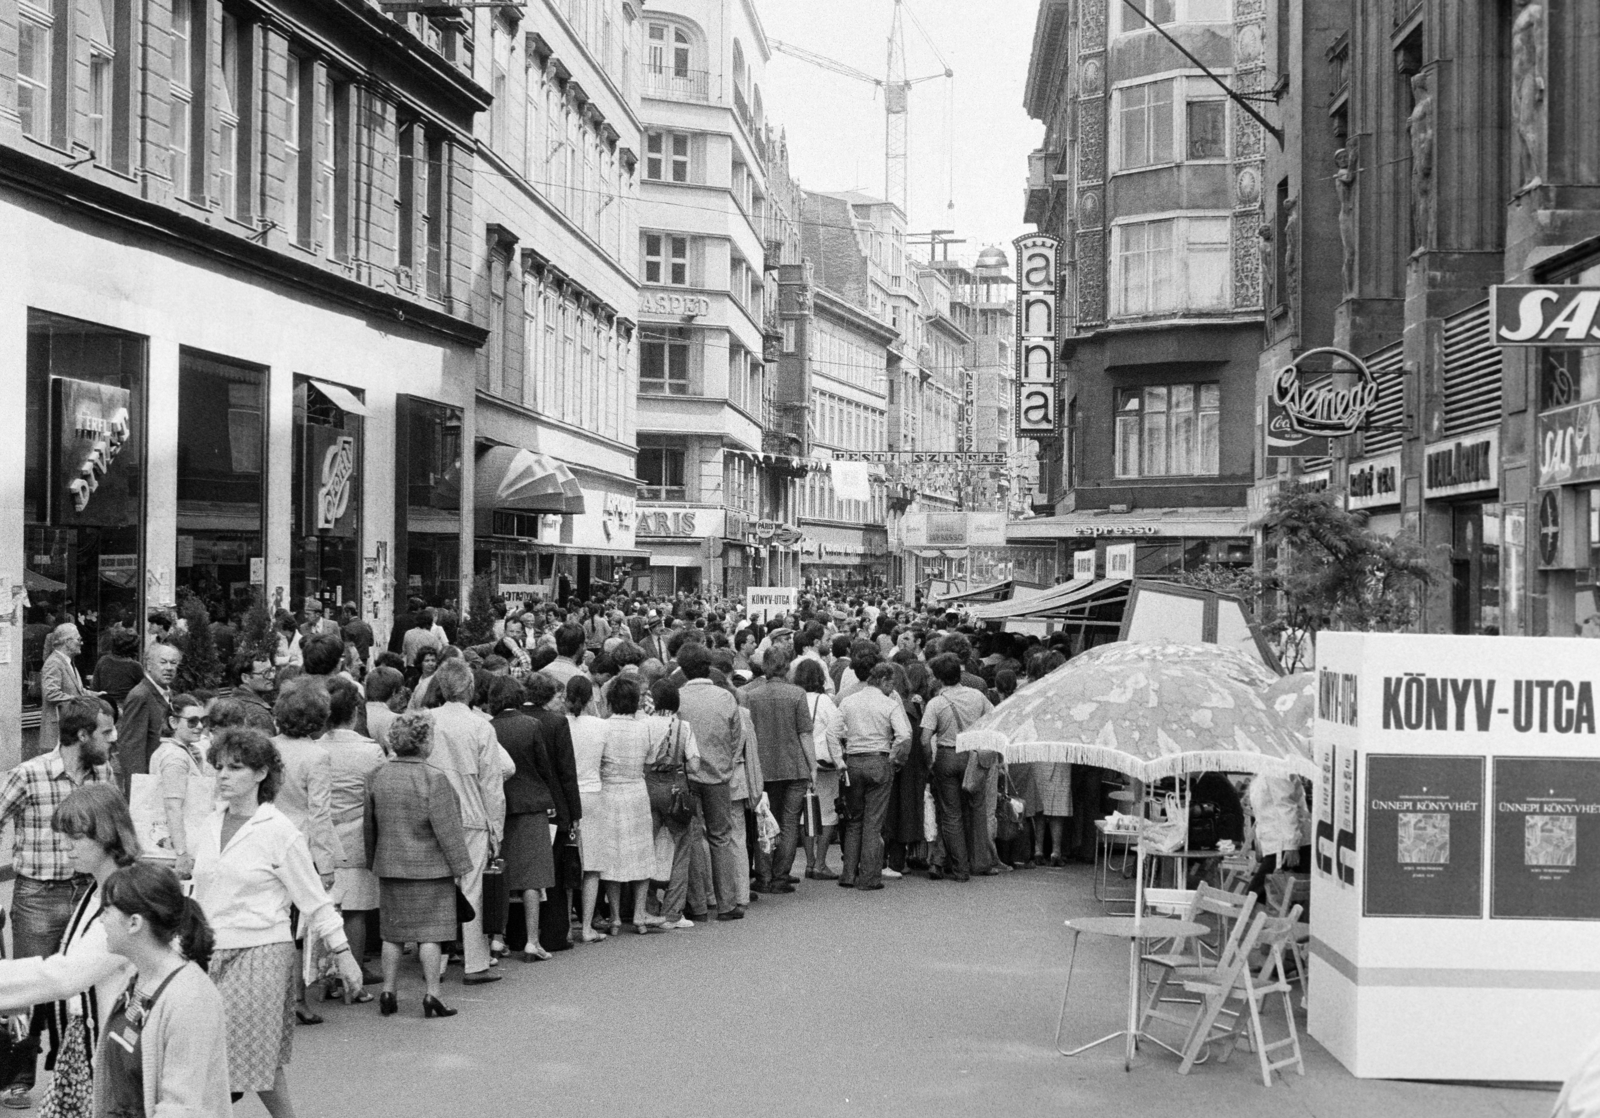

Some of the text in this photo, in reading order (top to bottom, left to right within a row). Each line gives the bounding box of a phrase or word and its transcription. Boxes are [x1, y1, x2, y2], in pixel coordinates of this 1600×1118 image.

[1023, 252, 1054, 425] anna
[1499, 289, 1600, 342] SA
[1274, 365, 1378, 429] Csemege
[1540, 426, 1575, 475] SAS
[635, 511, 696, 537] ARIS
[1073, 524, 1156, 538] espresso
[1382, 672, 1597, 734] KÖNYV-UTCA
[1371, 799, 1479, 812] ÜNNEPI KÖNYVHÉT
[1498, 801, 1540, 813] ÜNNEPI
